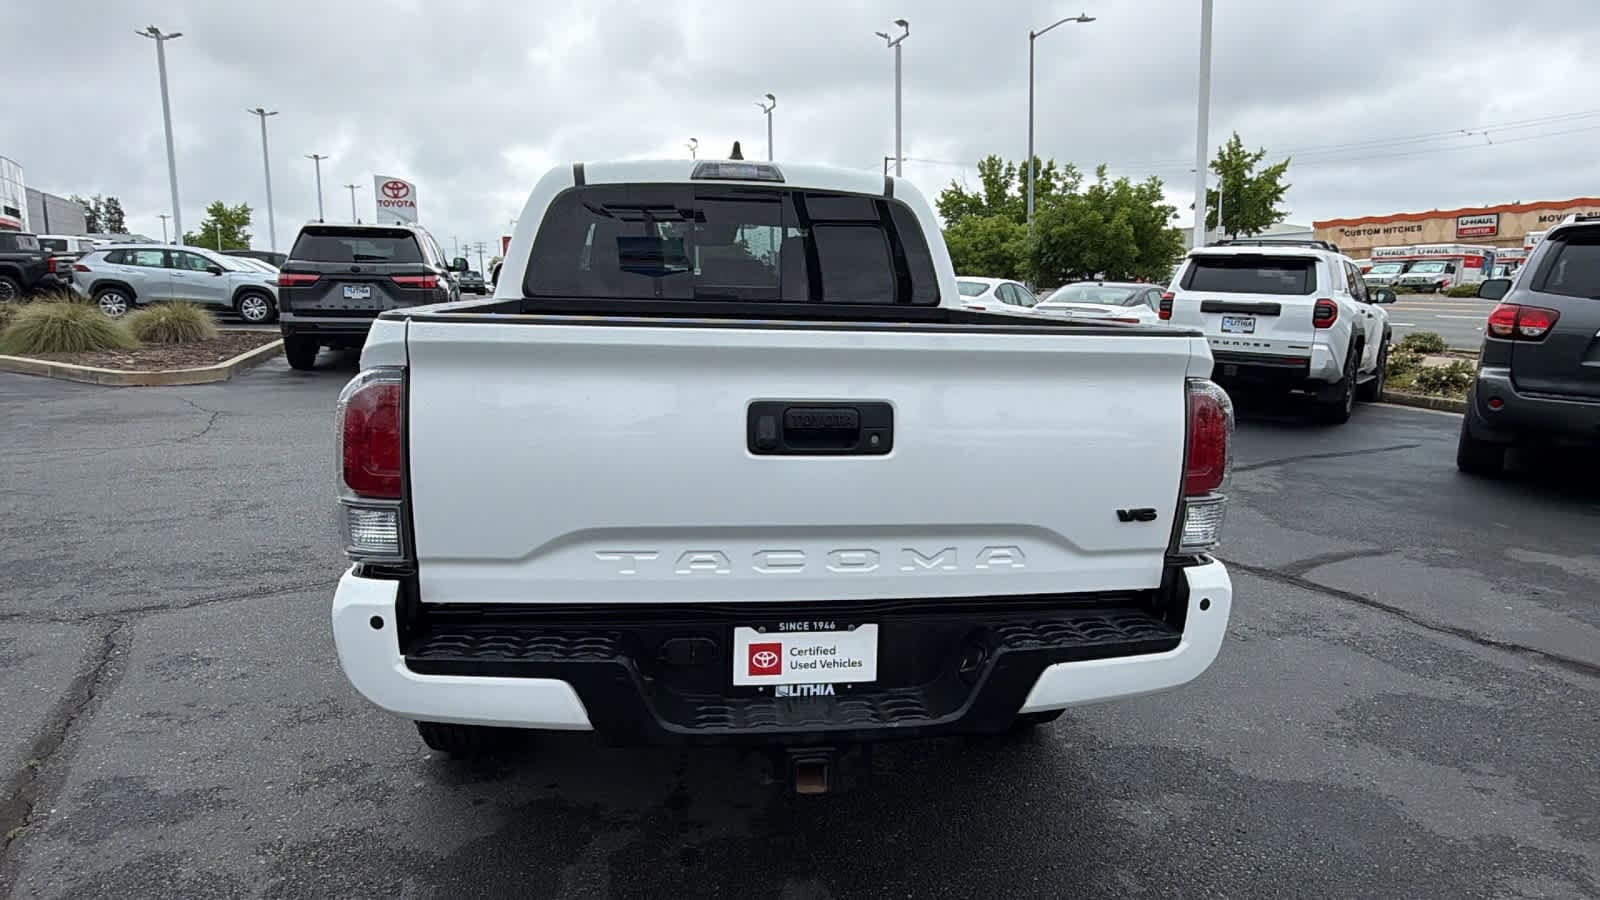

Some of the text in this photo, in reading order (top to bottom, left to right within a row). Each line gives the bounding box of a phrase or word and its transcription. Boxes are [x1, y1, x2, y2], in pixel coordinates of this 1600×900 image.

[377, 200, 416, 208] TOYOTA
[1344, 228, 1380, 237] CUSTOM
[1383, 225, 1422, 235] HITCHES
[1116, 508, 1158, 522] V6
[595, 546, 1027, 574] TACOMA
[779, 621, 836, 631] SINCE 1946
[789, 646, 836, 657] Certified
[789, 659, 863, 670] Used Vehicles
[789, 684, 835, 696] LITHIA
